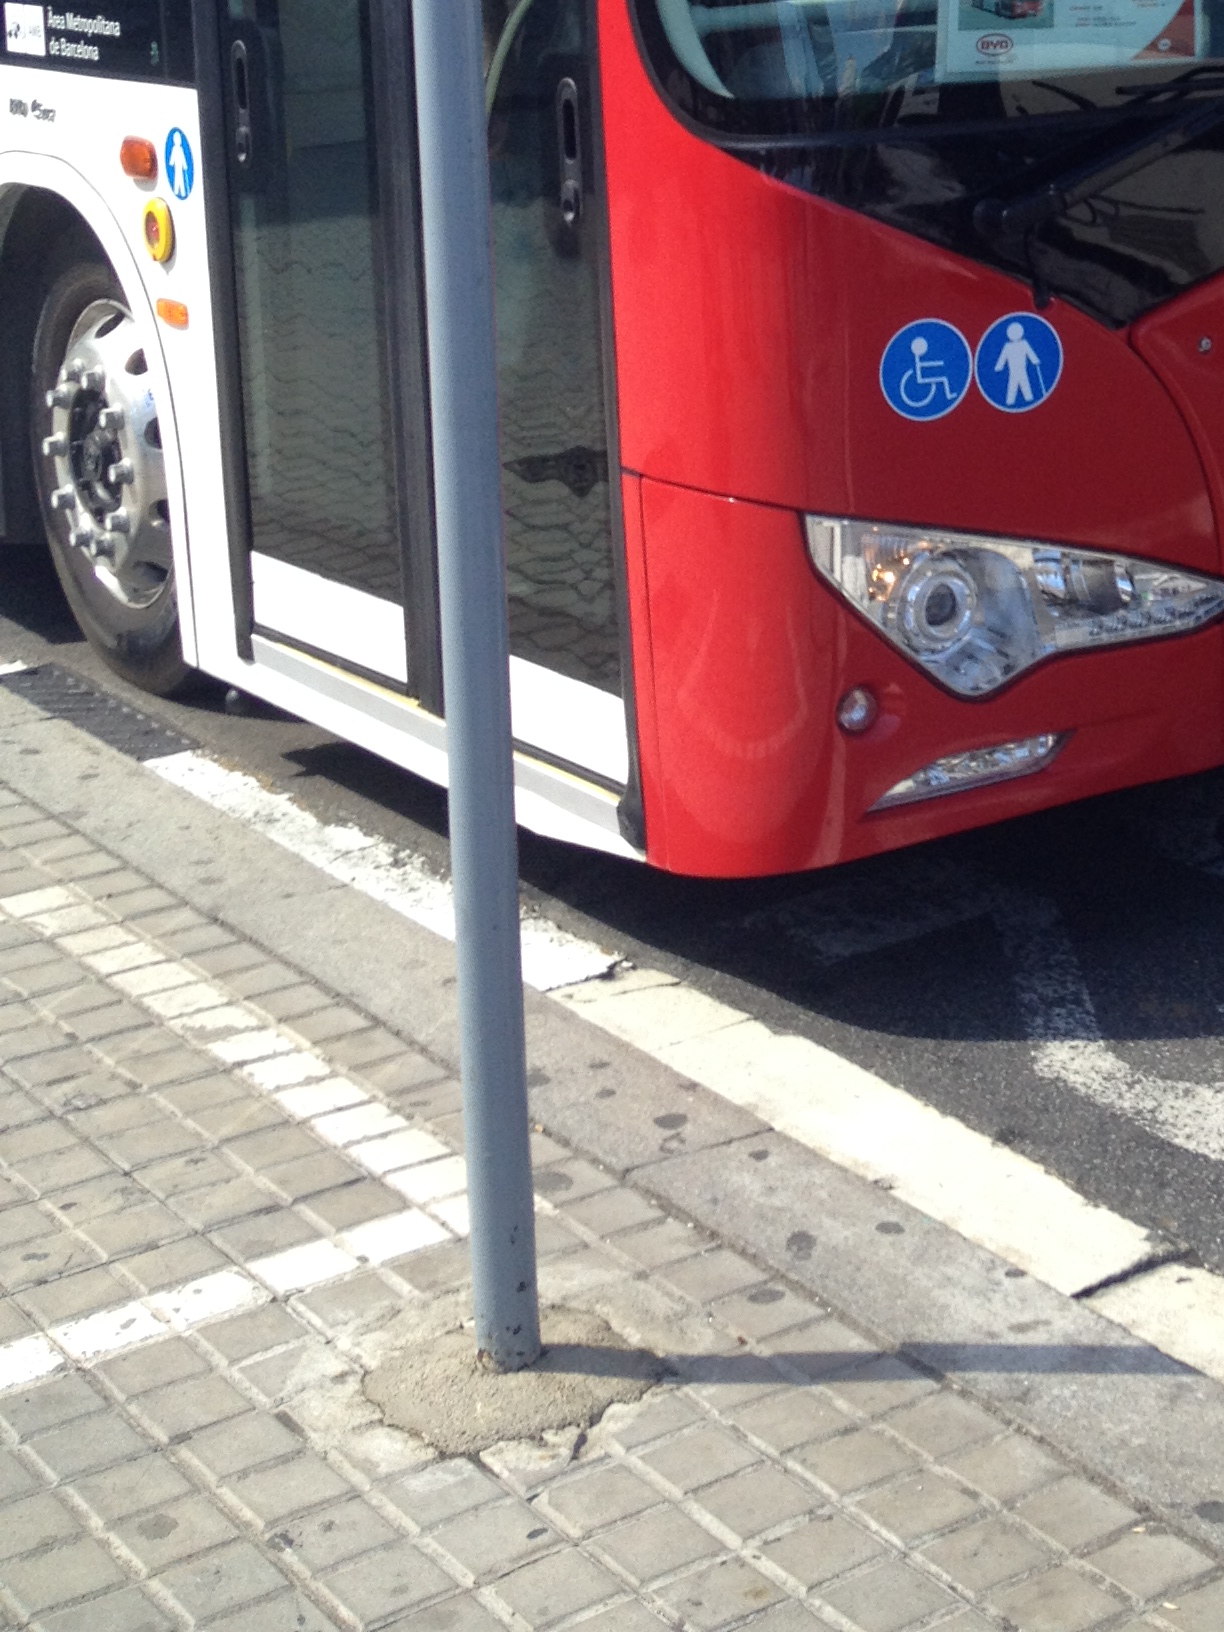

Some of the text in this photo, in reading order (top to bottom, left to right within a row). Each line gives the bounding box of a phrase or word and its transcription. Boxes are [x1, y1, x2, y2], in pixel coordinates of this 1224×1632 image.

[65, 12, 121, 37] Metropolitana
[49, 37, 100, 61] de Barcelona
